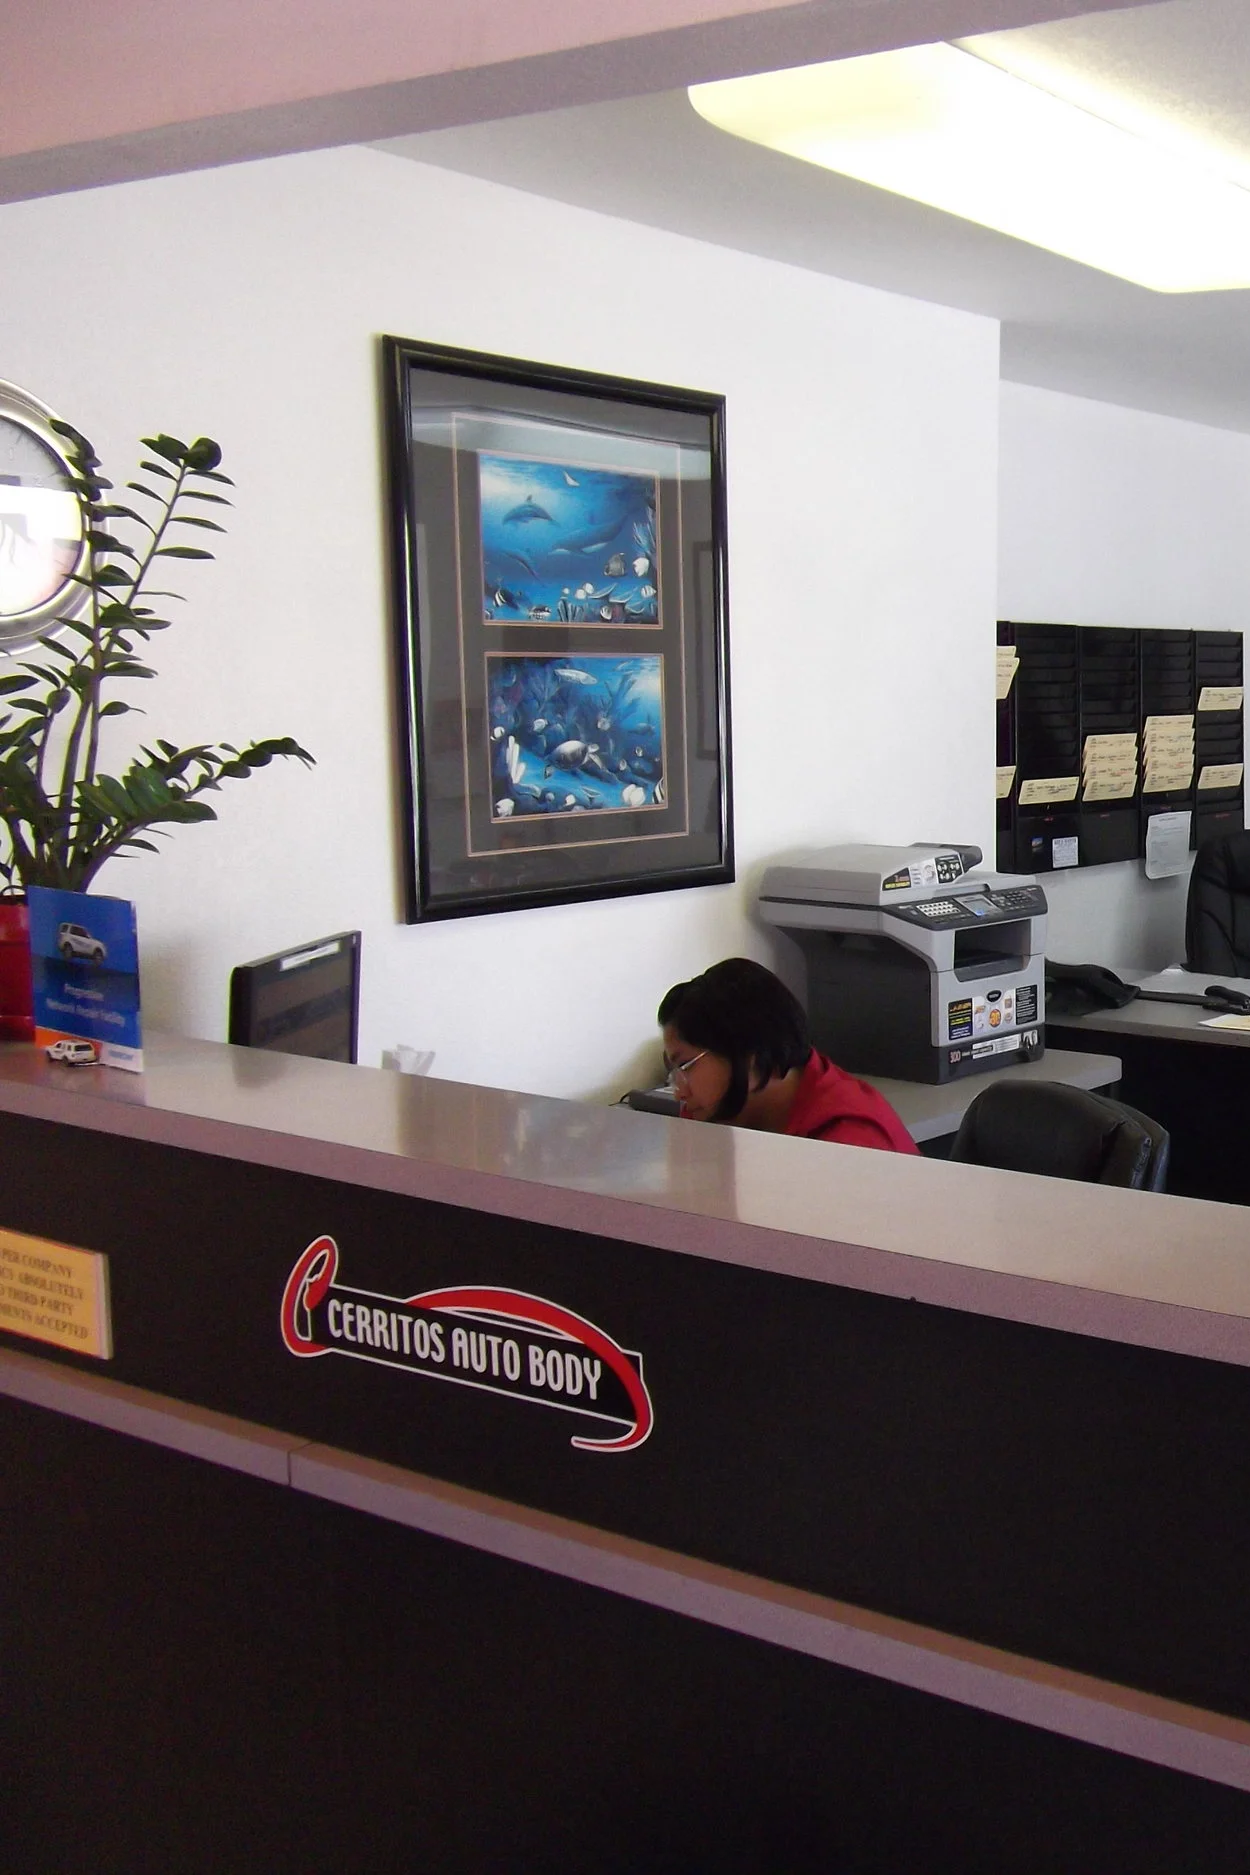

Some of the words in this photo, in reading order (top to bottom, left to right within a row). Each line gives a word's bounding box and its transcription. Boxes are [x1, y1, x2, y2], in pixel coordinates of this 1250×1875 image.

[22, 1255, 72, 1279] COMPANY
[19, 1271, 83, 1300] ABSOLUTELY
[41, 1296, 73, 1316] PARTY
[34, 1314, 88, 1340] ACCEPTED
[328, 1299, 446, 1363] CERRITOS
[452, 1327, 520, 1381] AUTO
[528, 1345, 601, 1400] BODY
